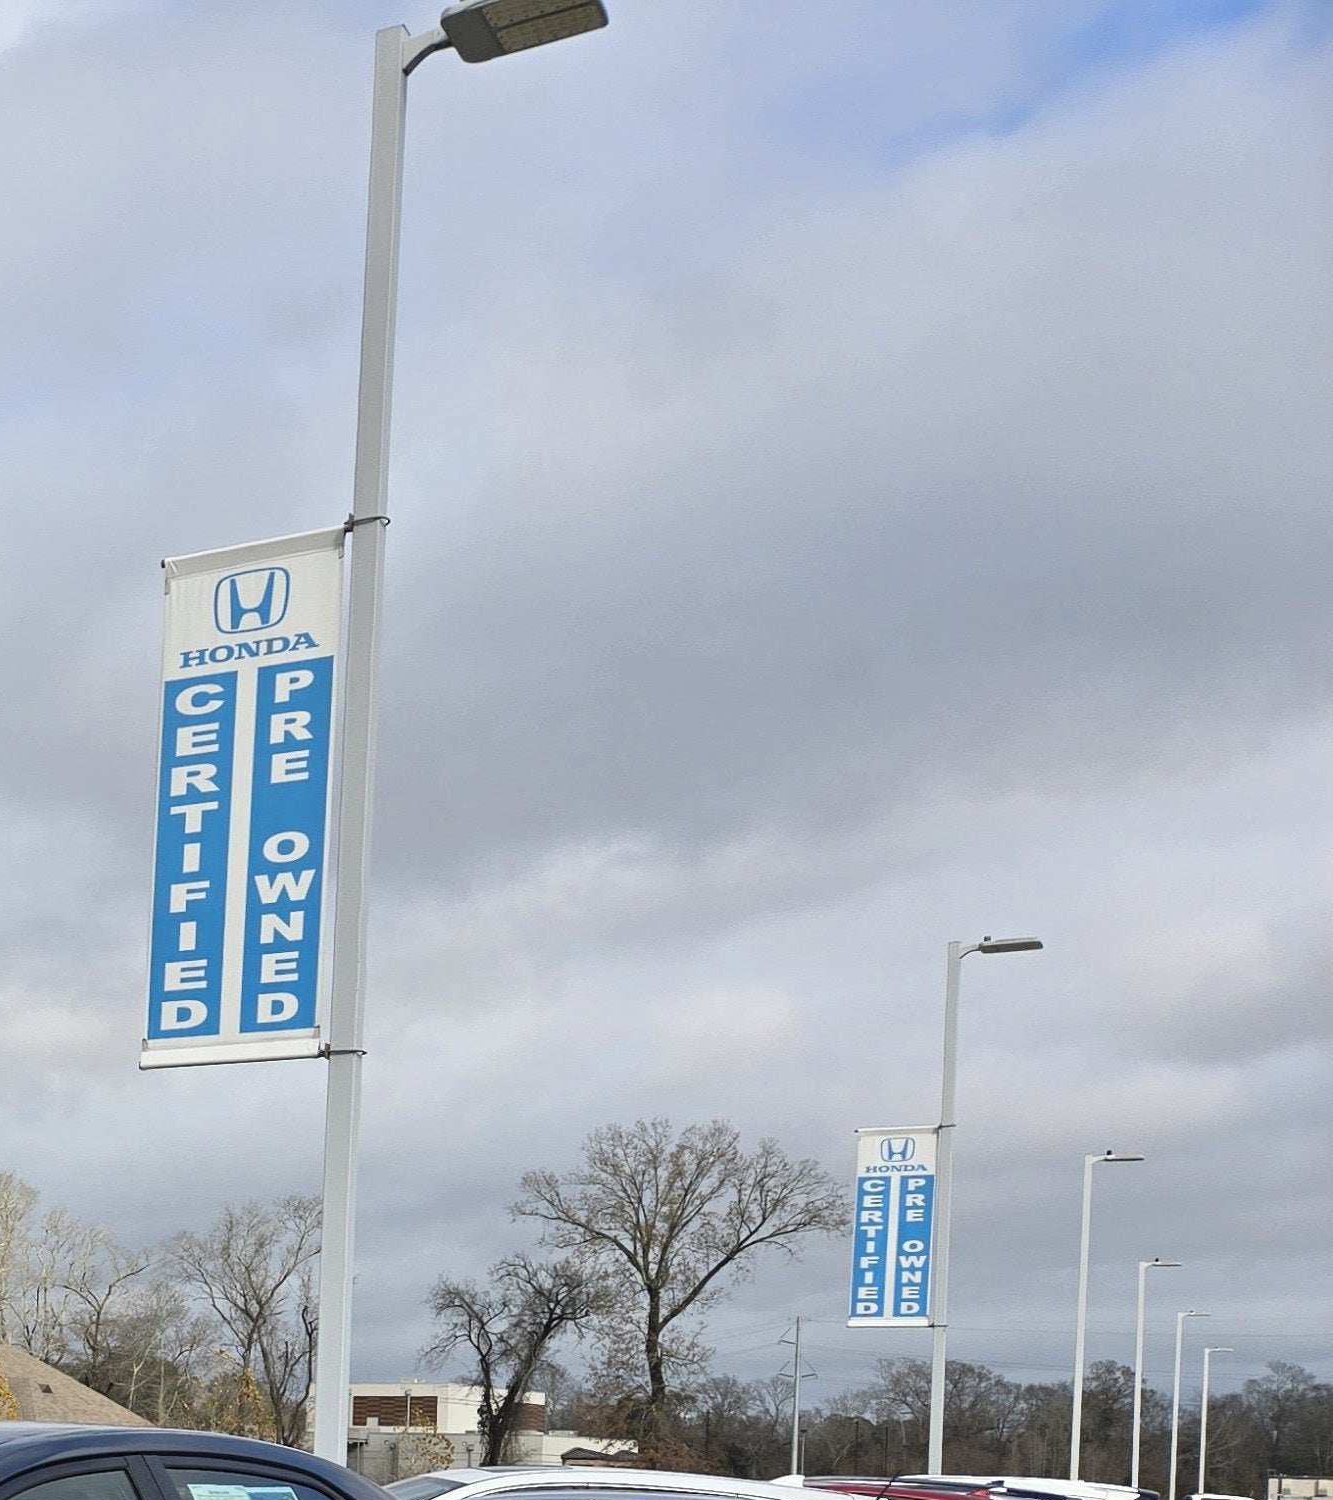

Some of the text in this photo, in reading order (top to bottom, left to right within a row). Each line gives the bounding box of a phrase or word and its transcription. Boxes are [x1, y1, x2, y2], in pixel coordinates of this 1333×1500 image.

[179, 630, 320, 668] HONDA
[159, 683, 225, 1031] CERTIFIED
[254, 669, 316, 1026] PRE OWNED
[865, 1164, 928, 1174] HONDA
[855, 1179, 886, 1315] CERTIFIED
[899, 1178, 927, 1315] PRE OWNED
